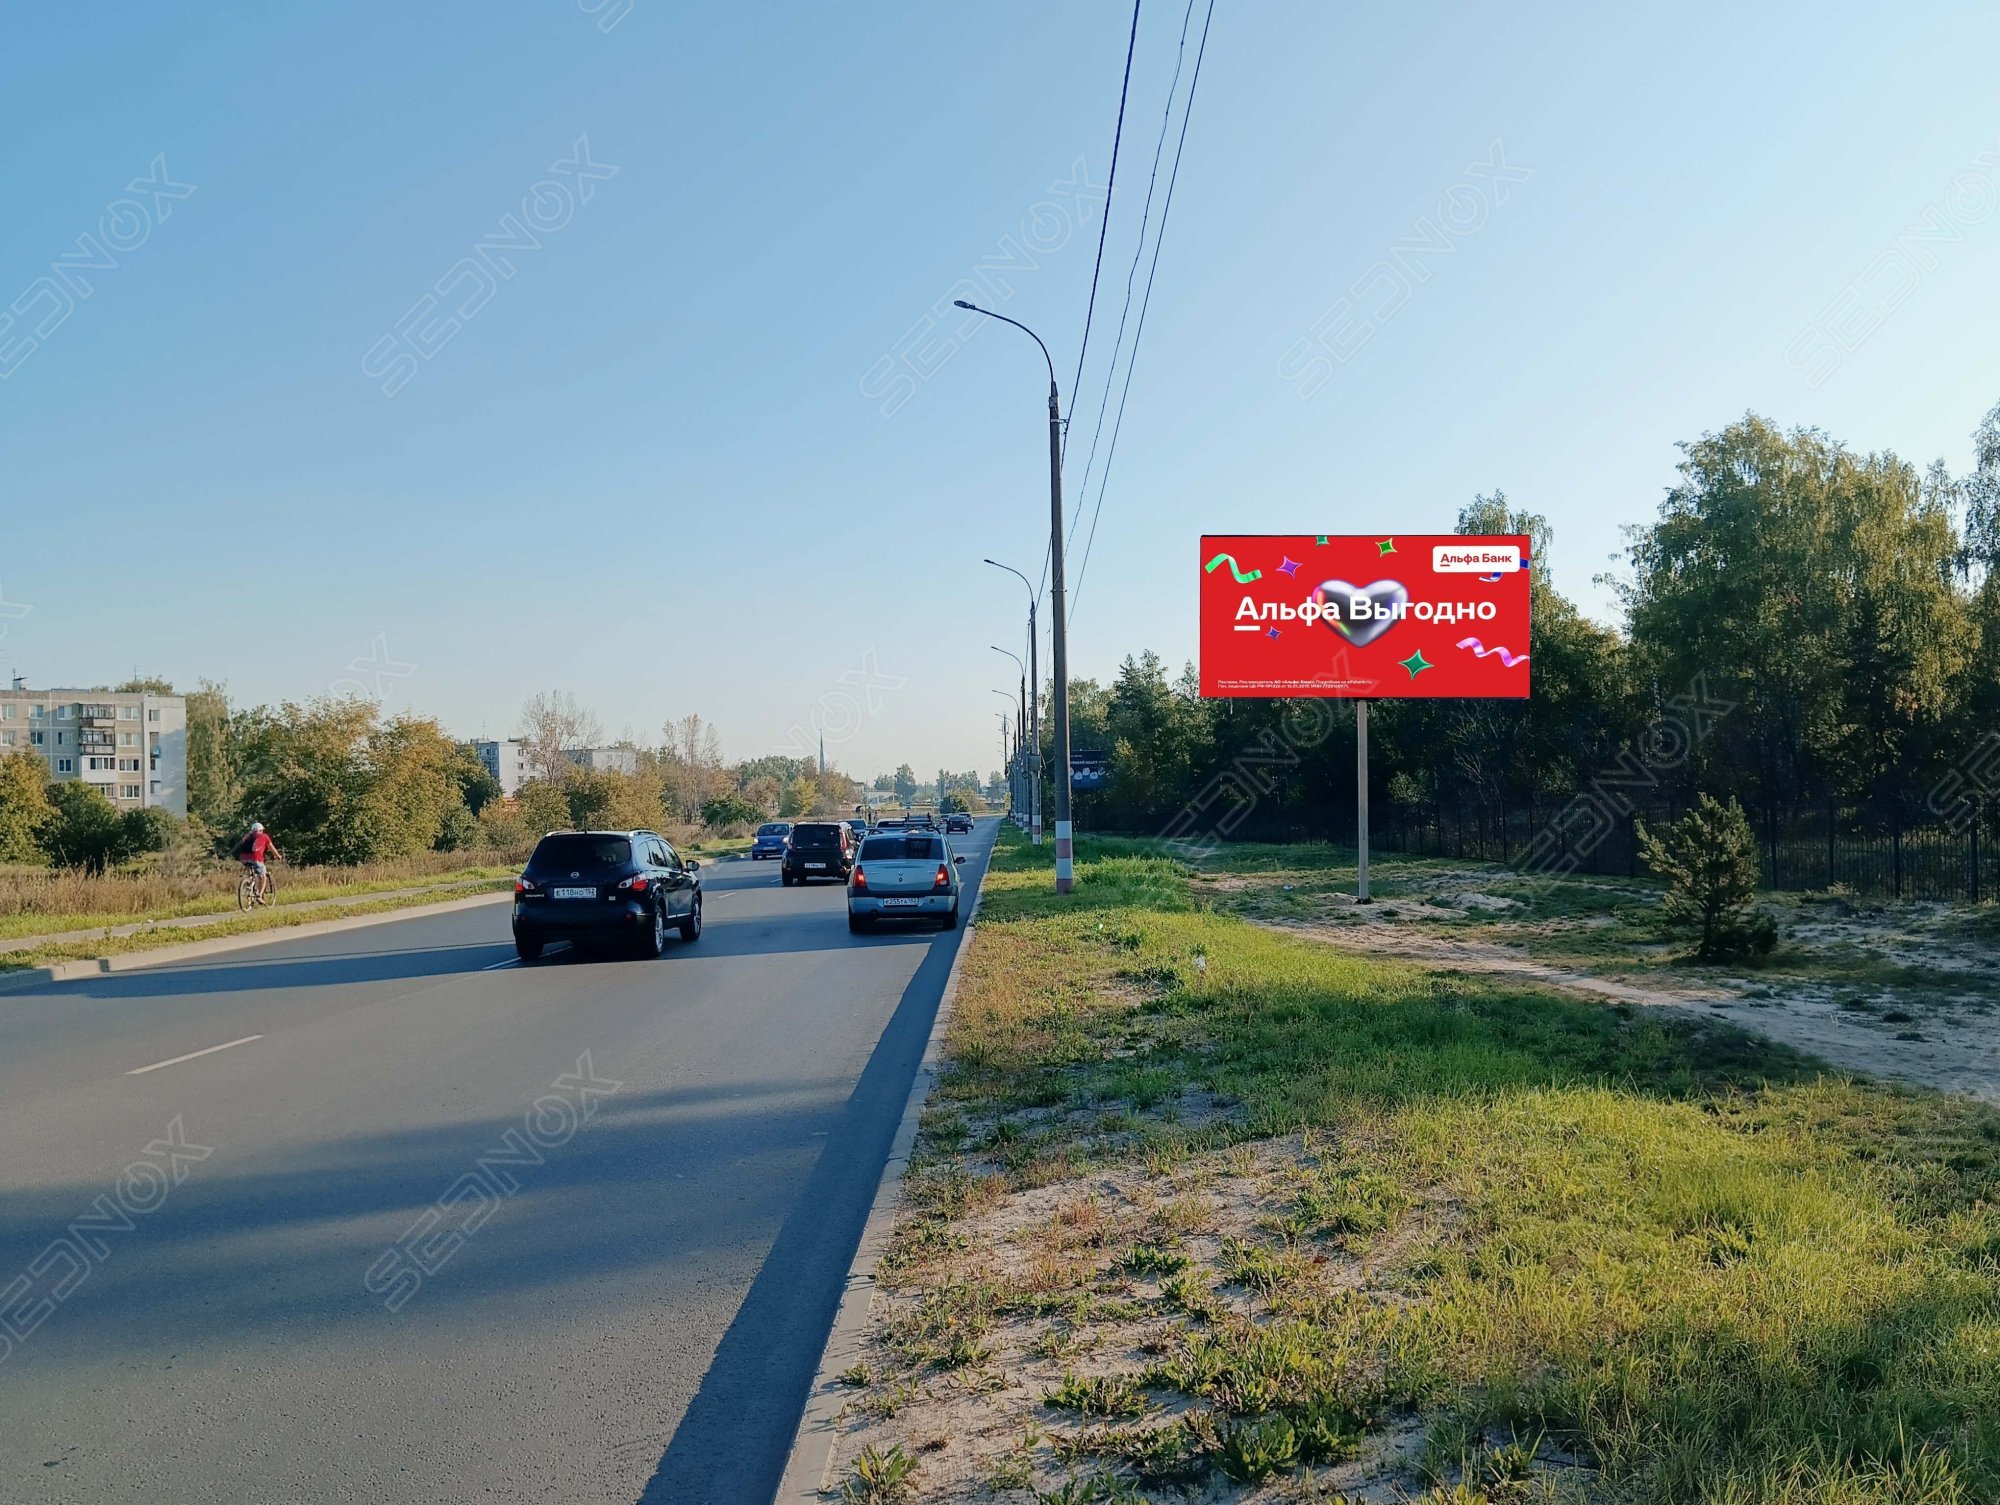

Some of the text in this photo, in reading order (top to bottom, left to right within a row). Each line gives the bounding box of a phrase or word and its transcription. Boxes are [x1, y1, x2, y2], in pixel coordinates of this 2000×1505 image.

[1440, 553, 1512, 566] Альфа Банк
[1234, 596, 1496, 630] Альфа Выгодно
